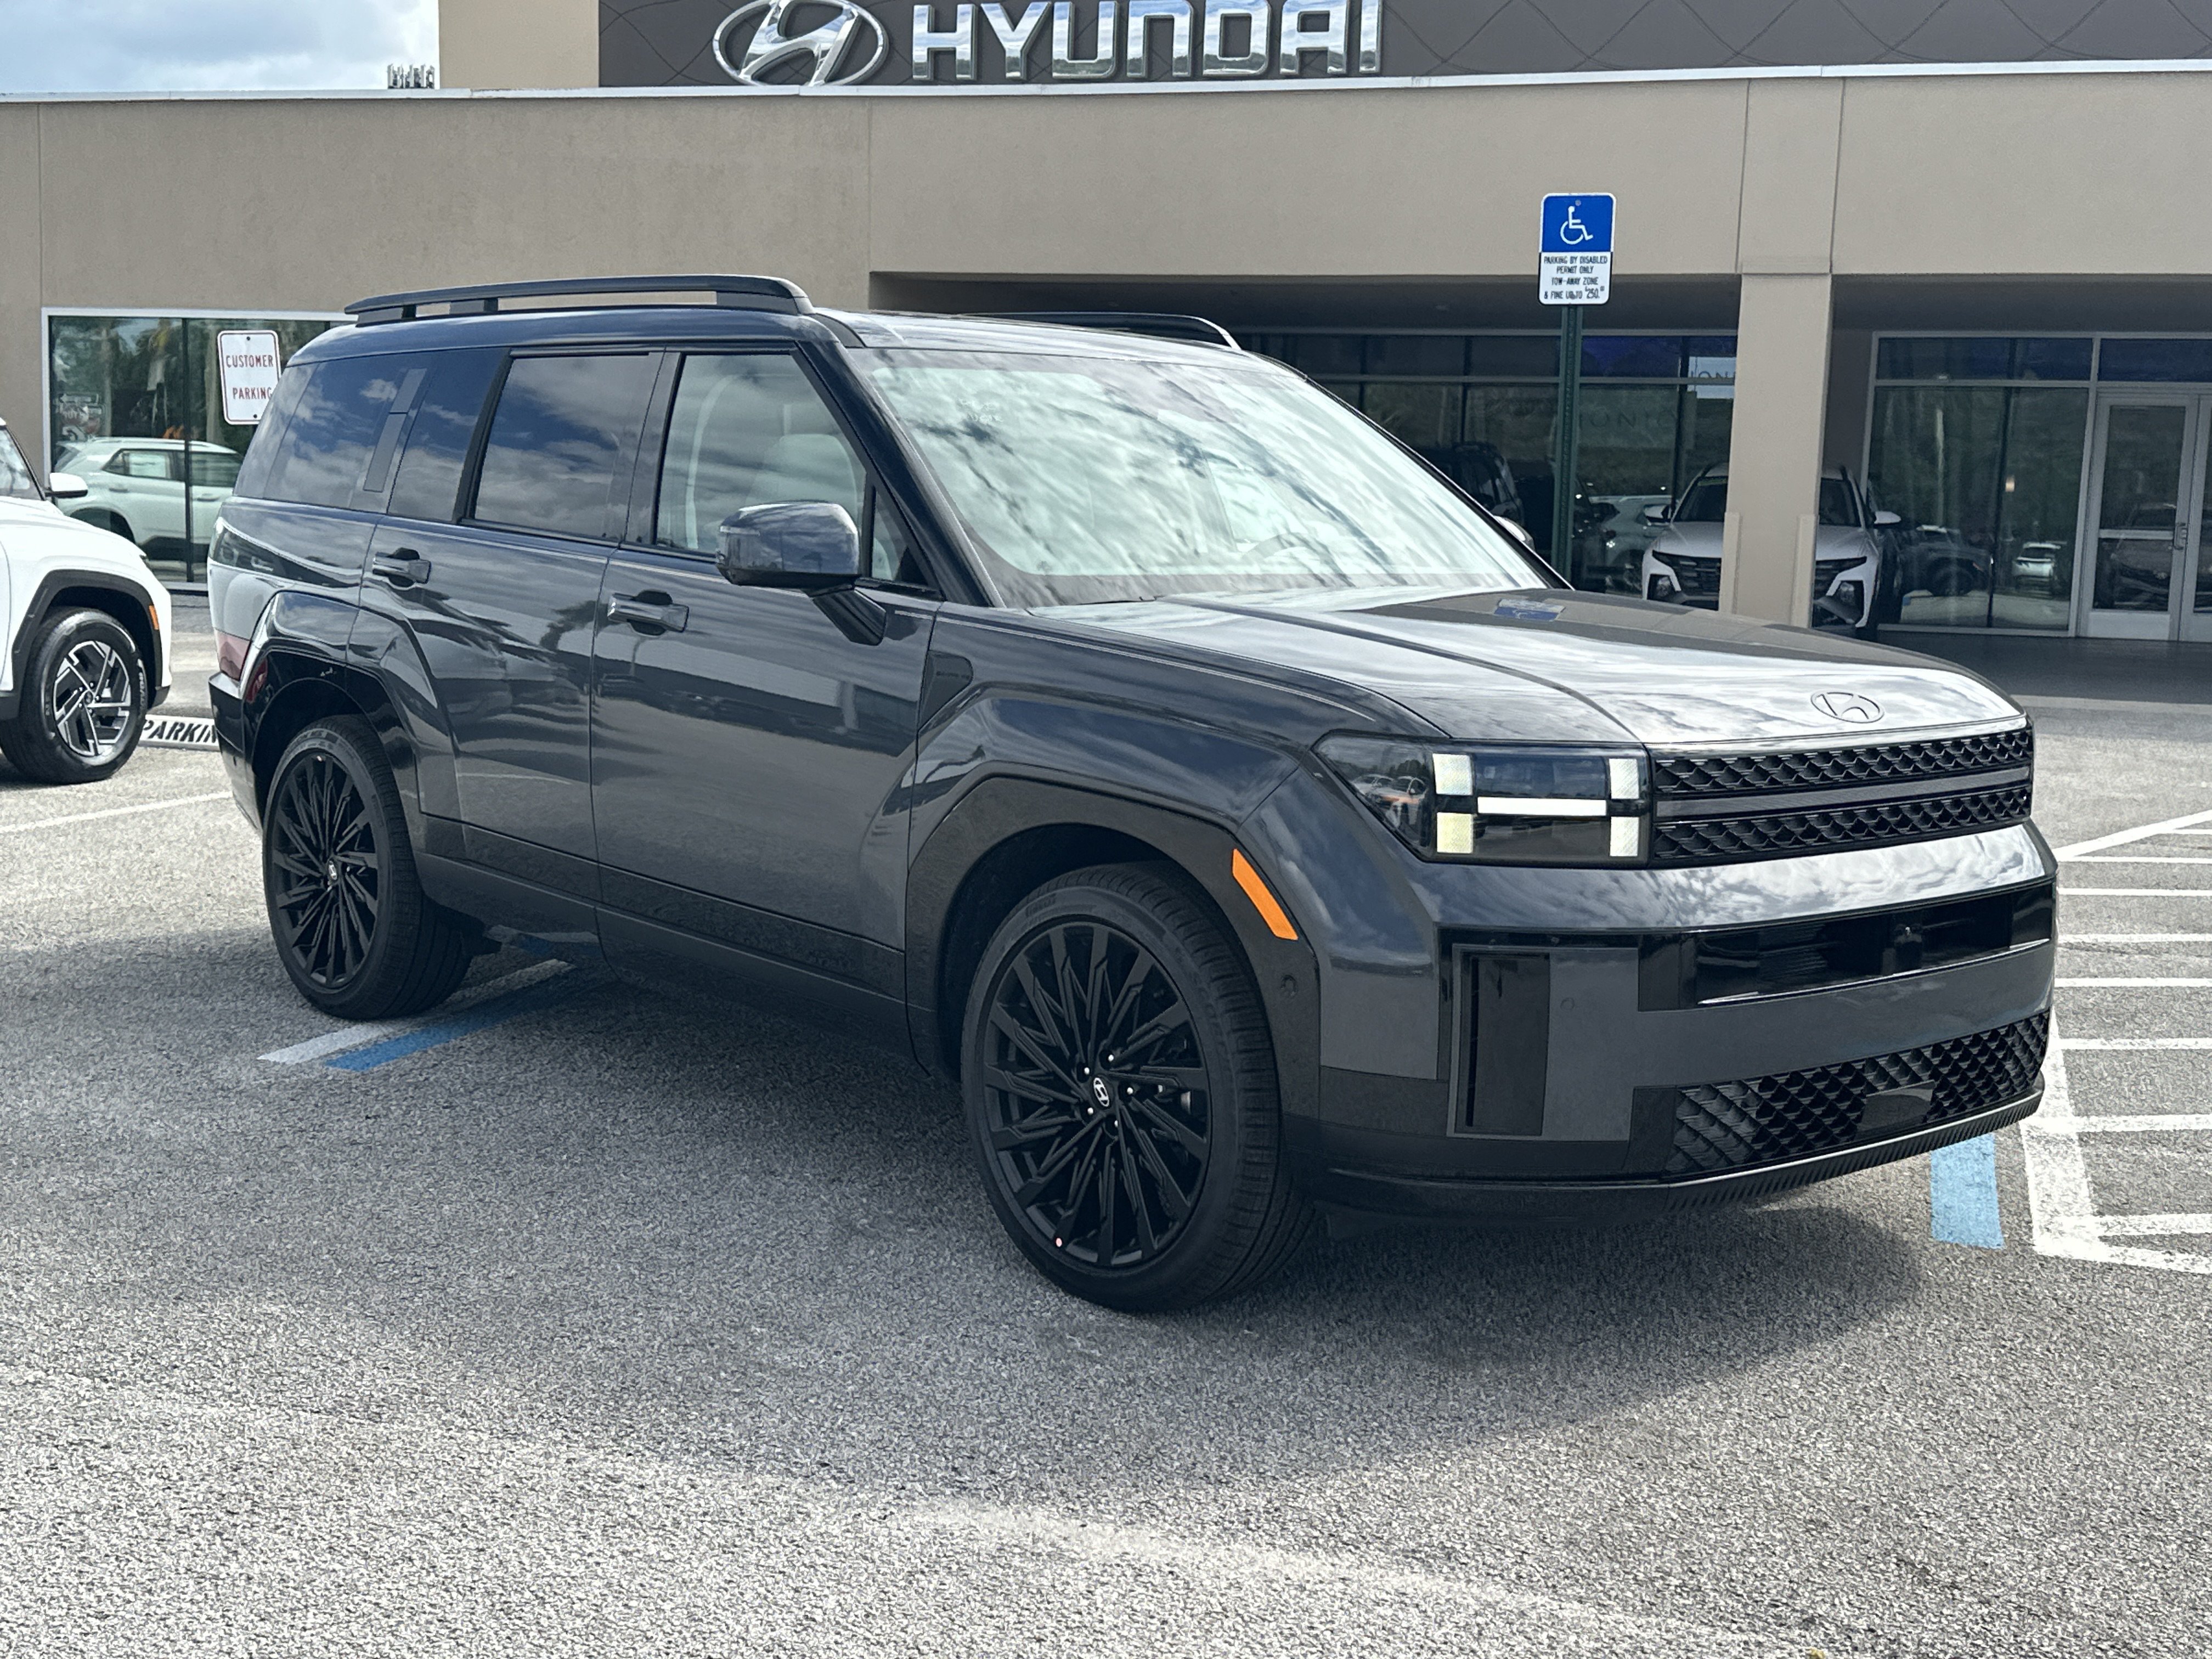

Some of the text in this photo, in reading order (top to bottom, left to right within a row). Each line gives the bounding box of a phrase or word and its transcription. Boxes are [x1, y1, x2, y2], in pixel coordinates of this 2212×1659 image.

[913, 0, 1381, 80] HYUNDAI
[1543, 256, 1607, 264] PARKING BY DISABLED
[1556, 266, 1594, 274] PERMIT ONLY
[1551, 276, 1599, 285] TOW-AWAY ZONE
[1544, 290, 1548, 299] &
[1550, 291, 1563, 299] FINE
[225, 355, 274, 368] CUSTOMER
[232, 387, 273, 400] PARKING
